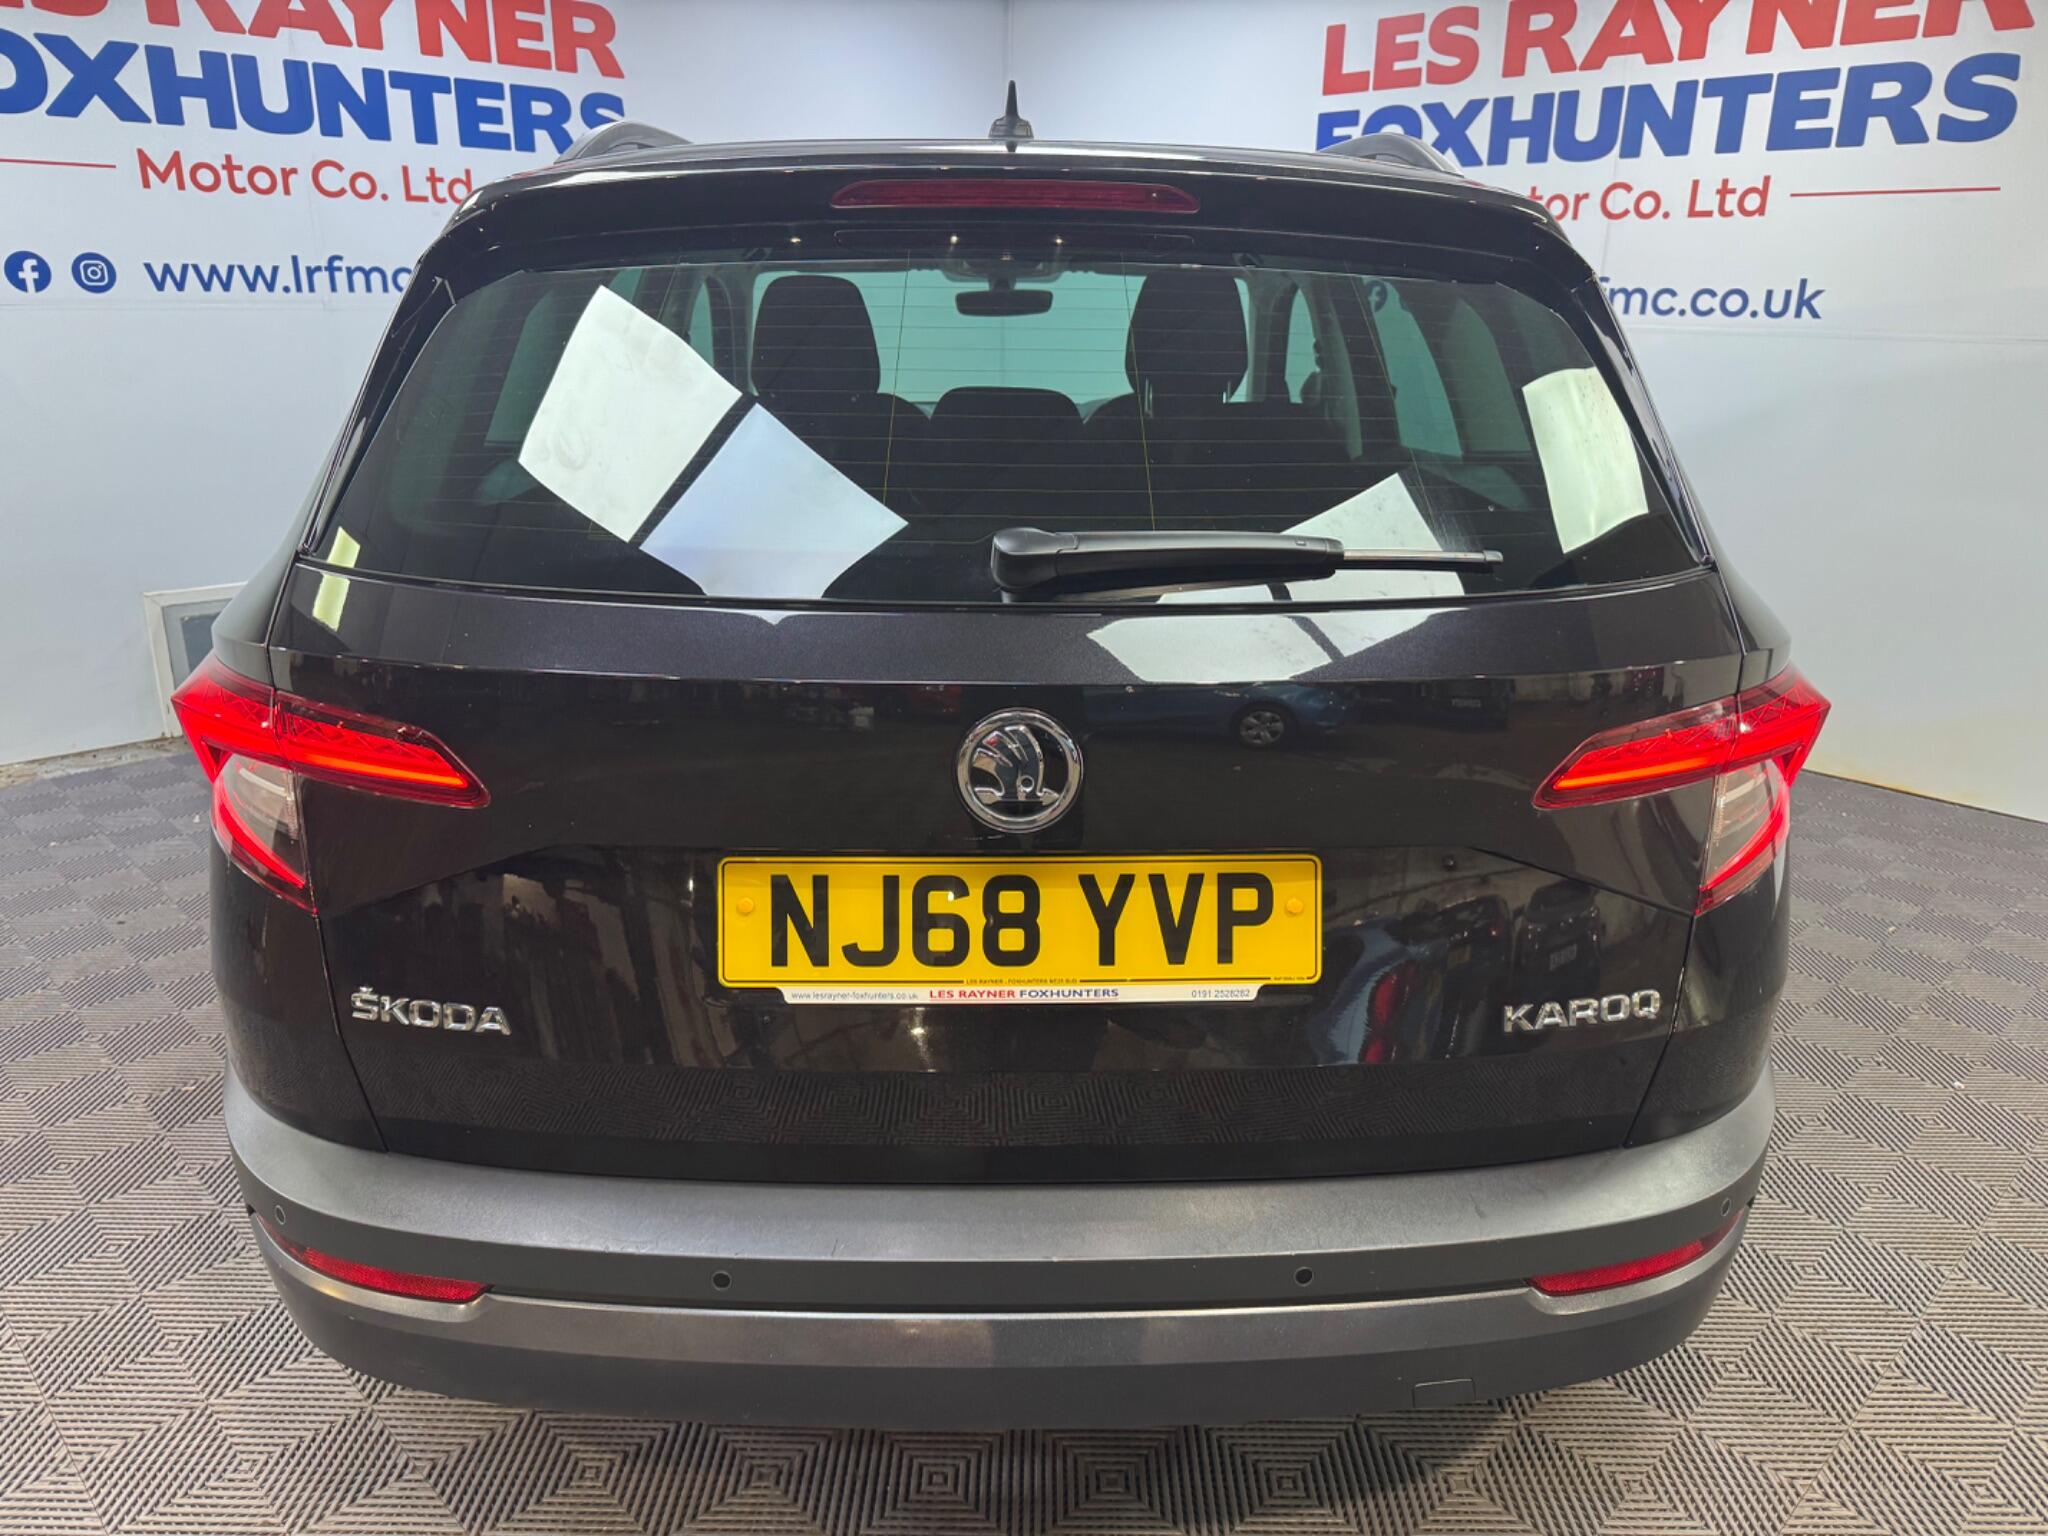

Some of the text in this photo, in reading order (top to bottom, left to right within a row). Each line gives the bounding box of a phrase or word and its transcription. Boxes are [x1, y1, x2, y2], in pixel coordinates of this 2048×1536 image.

[1322, 6, 1480, 96] LES
[136, 147, 473, 205] Motor Co. Ltd
[1600, 181, 1670, 220] Co.
[1687, 175, 1771, 219] Ltd
[1599, 276, 1826, 319] mc.co.uk
[770, 872, 1274, 968] NJ68 YVP
[350, 985, 512, 1036] ŠKODA
[929, 988, 1120, 999] LES RAYNER FOXHUNTERS
[1191, 989, 1212, 998] 0191
[1503, 988, 1661, 1033] KAROQ
